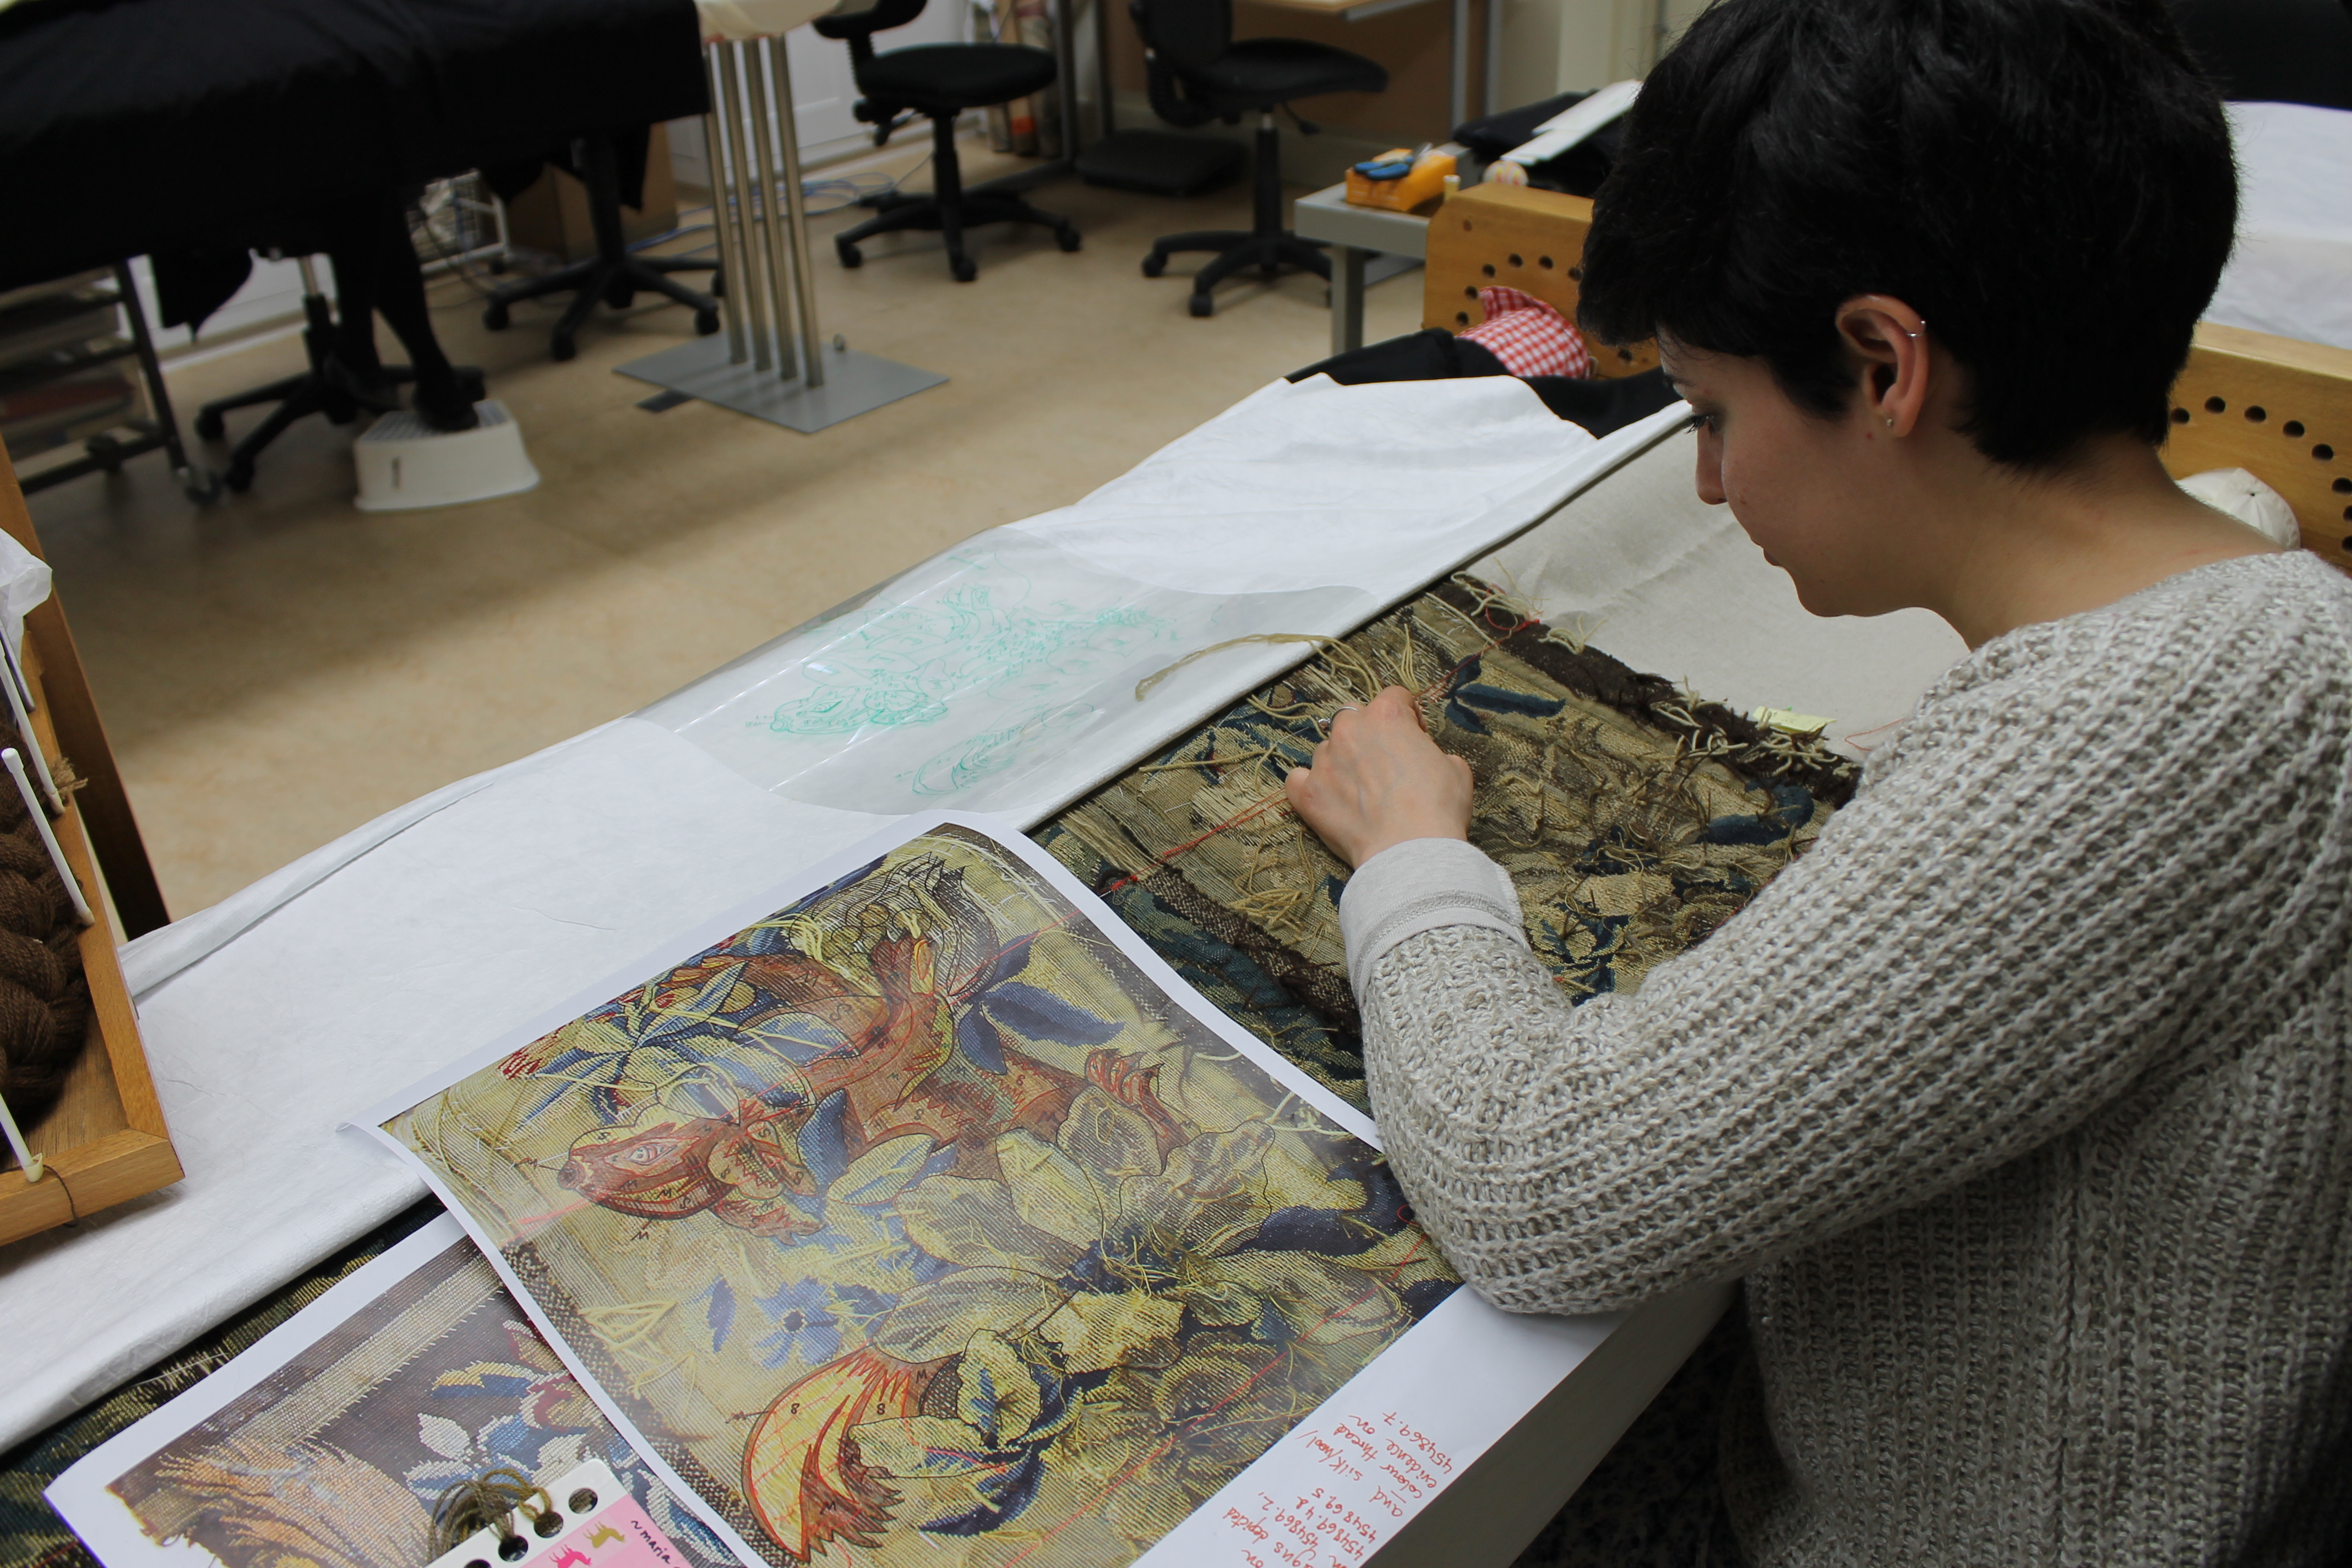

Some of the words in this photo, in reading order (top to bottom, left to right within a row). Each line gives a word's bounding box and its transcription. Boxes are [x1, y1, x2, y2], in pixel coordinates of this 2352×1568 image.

[1333, 1422, 1378, 1462] thread
[1348, 1414, 1375, 1435] on
[1382, 1411, 1452, 1475] 454869.7
[1379, 1464, 1423, 1499] colour
[1385, 1438, 1437, 1489] evidence
[1369, 1485, 1403, 1517] and
[1222, 1506, 1269, 1544] depicted
